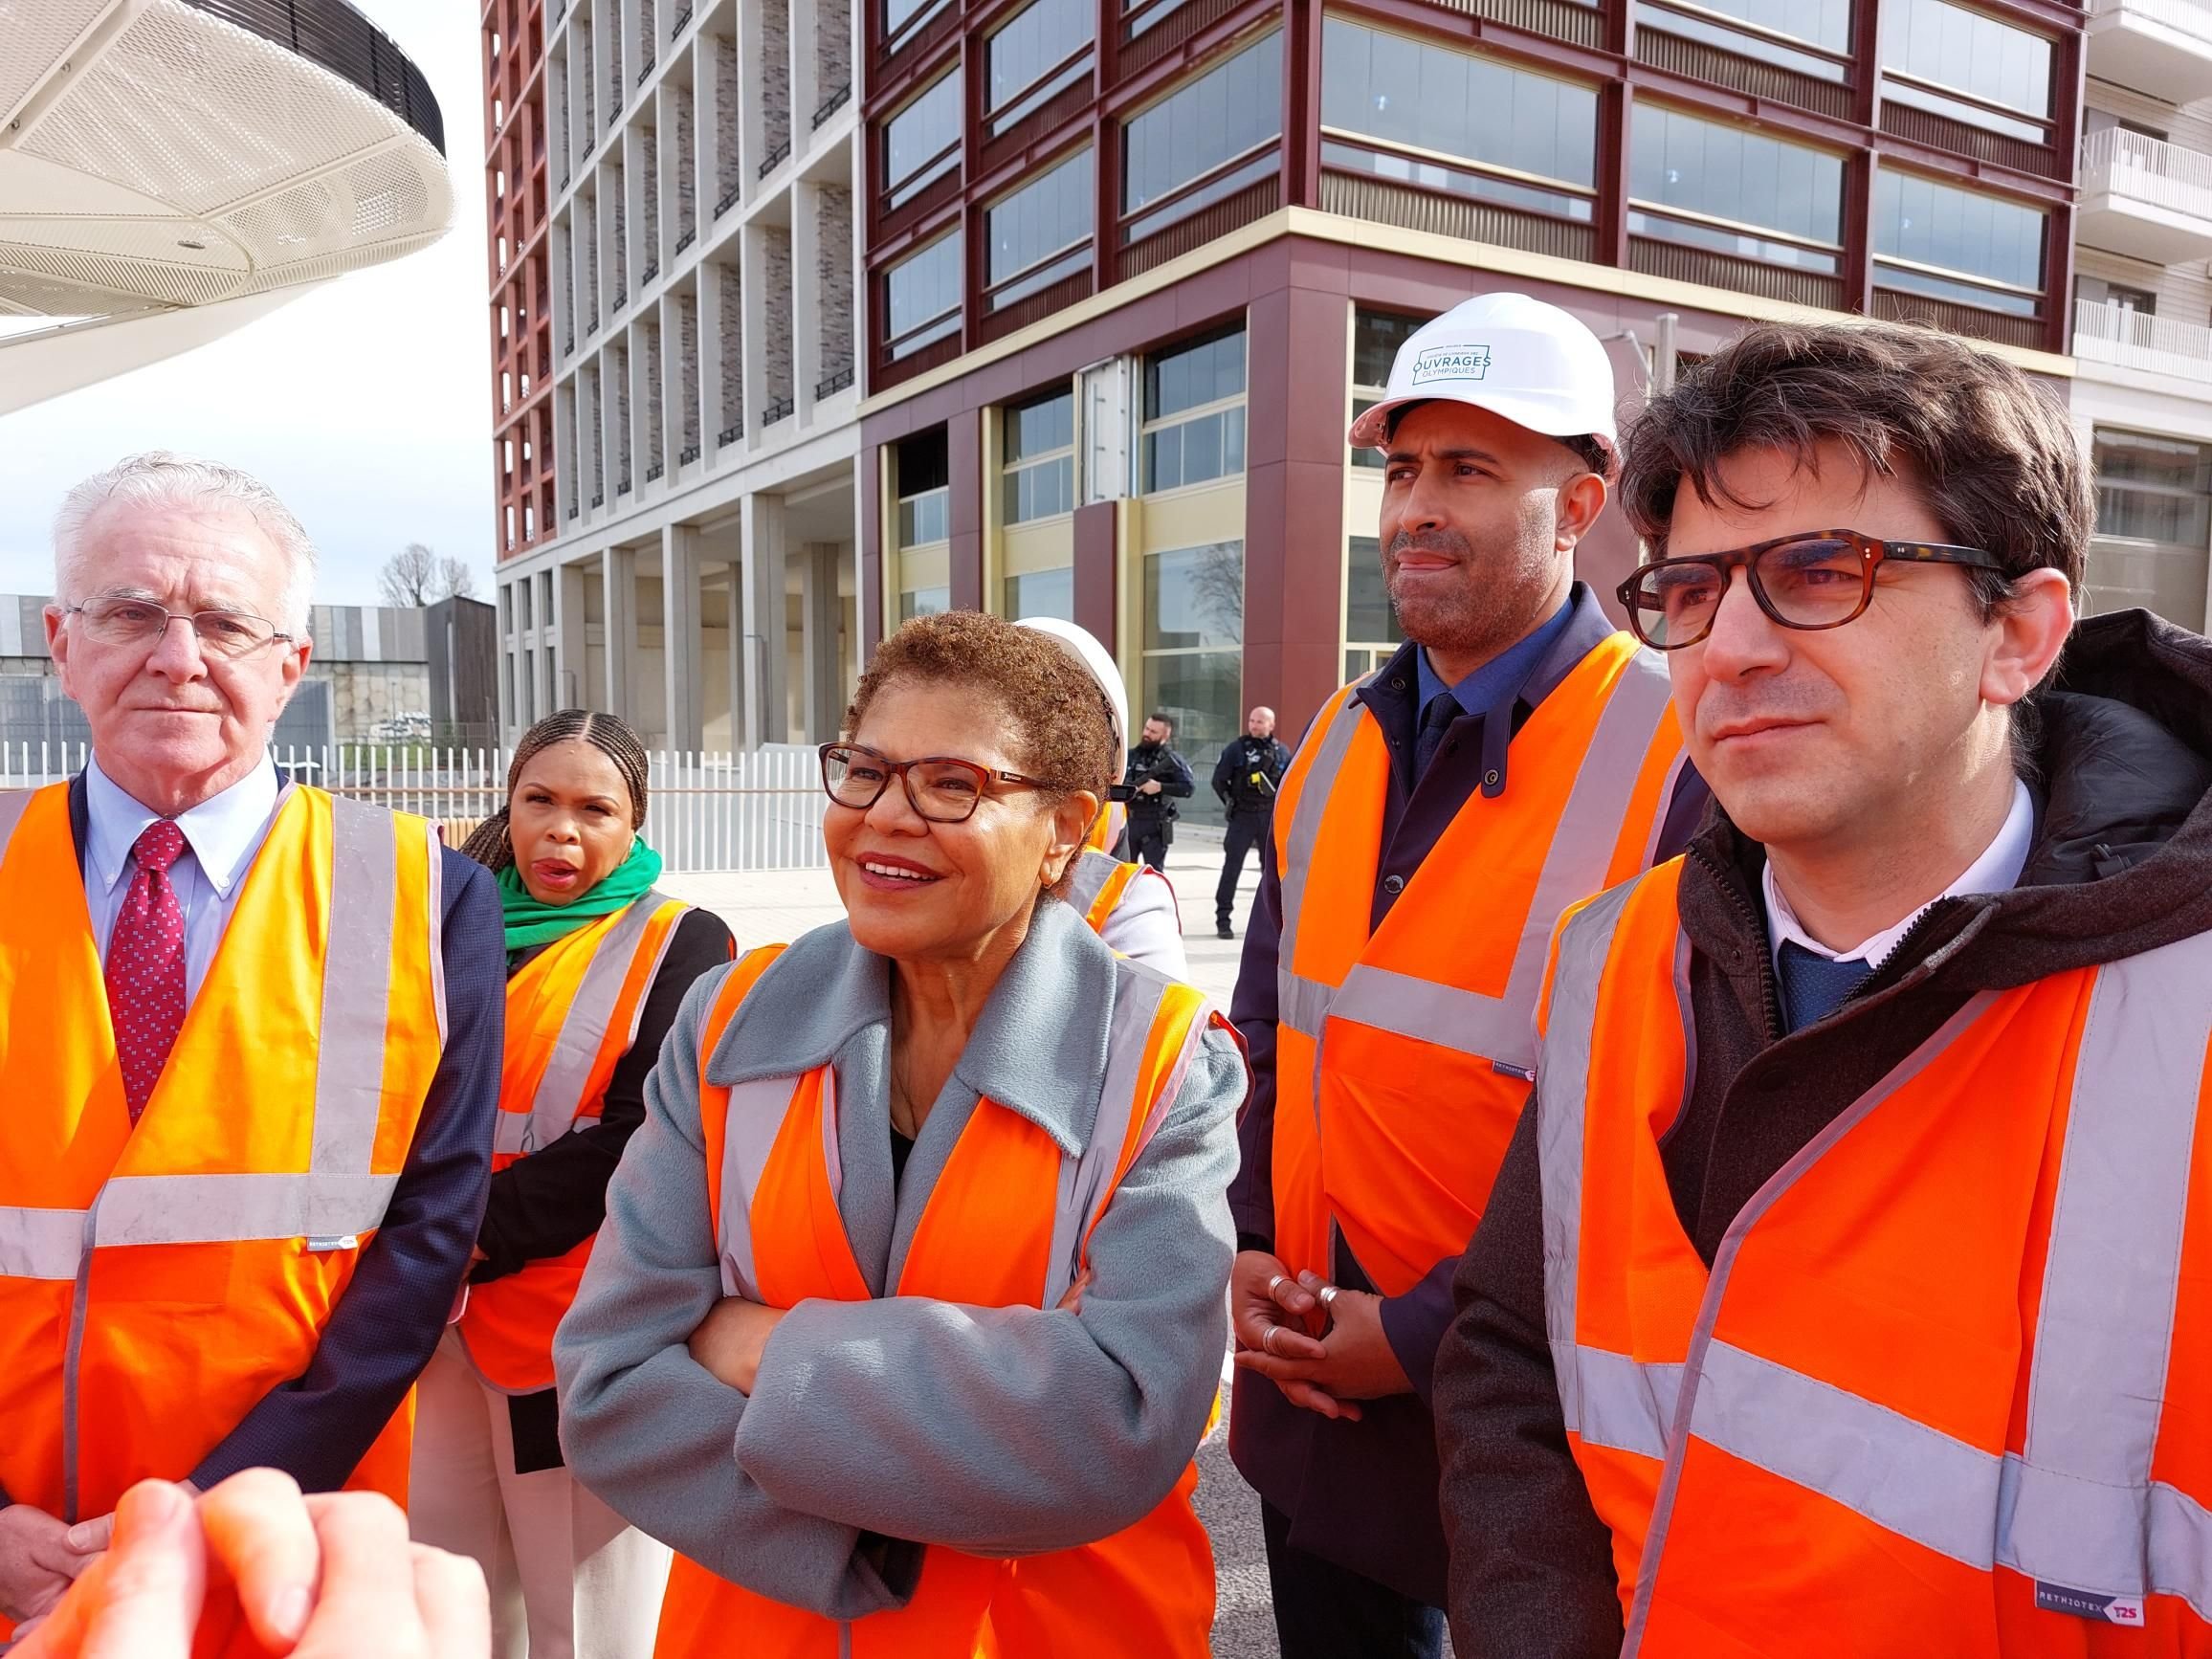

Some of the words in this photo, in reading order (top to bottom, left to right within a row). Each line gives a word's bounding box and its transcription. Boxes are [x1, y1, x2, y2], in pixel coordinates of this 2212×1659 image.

[1413, 357, 1492, 372] OUVRAGES
[1423, 367, 1476, 378] OLYMPIQUES
[2039, 1591, 2102, 1613] RETHIOTEX
[2113, 1606, 2137, 1619] T2S
